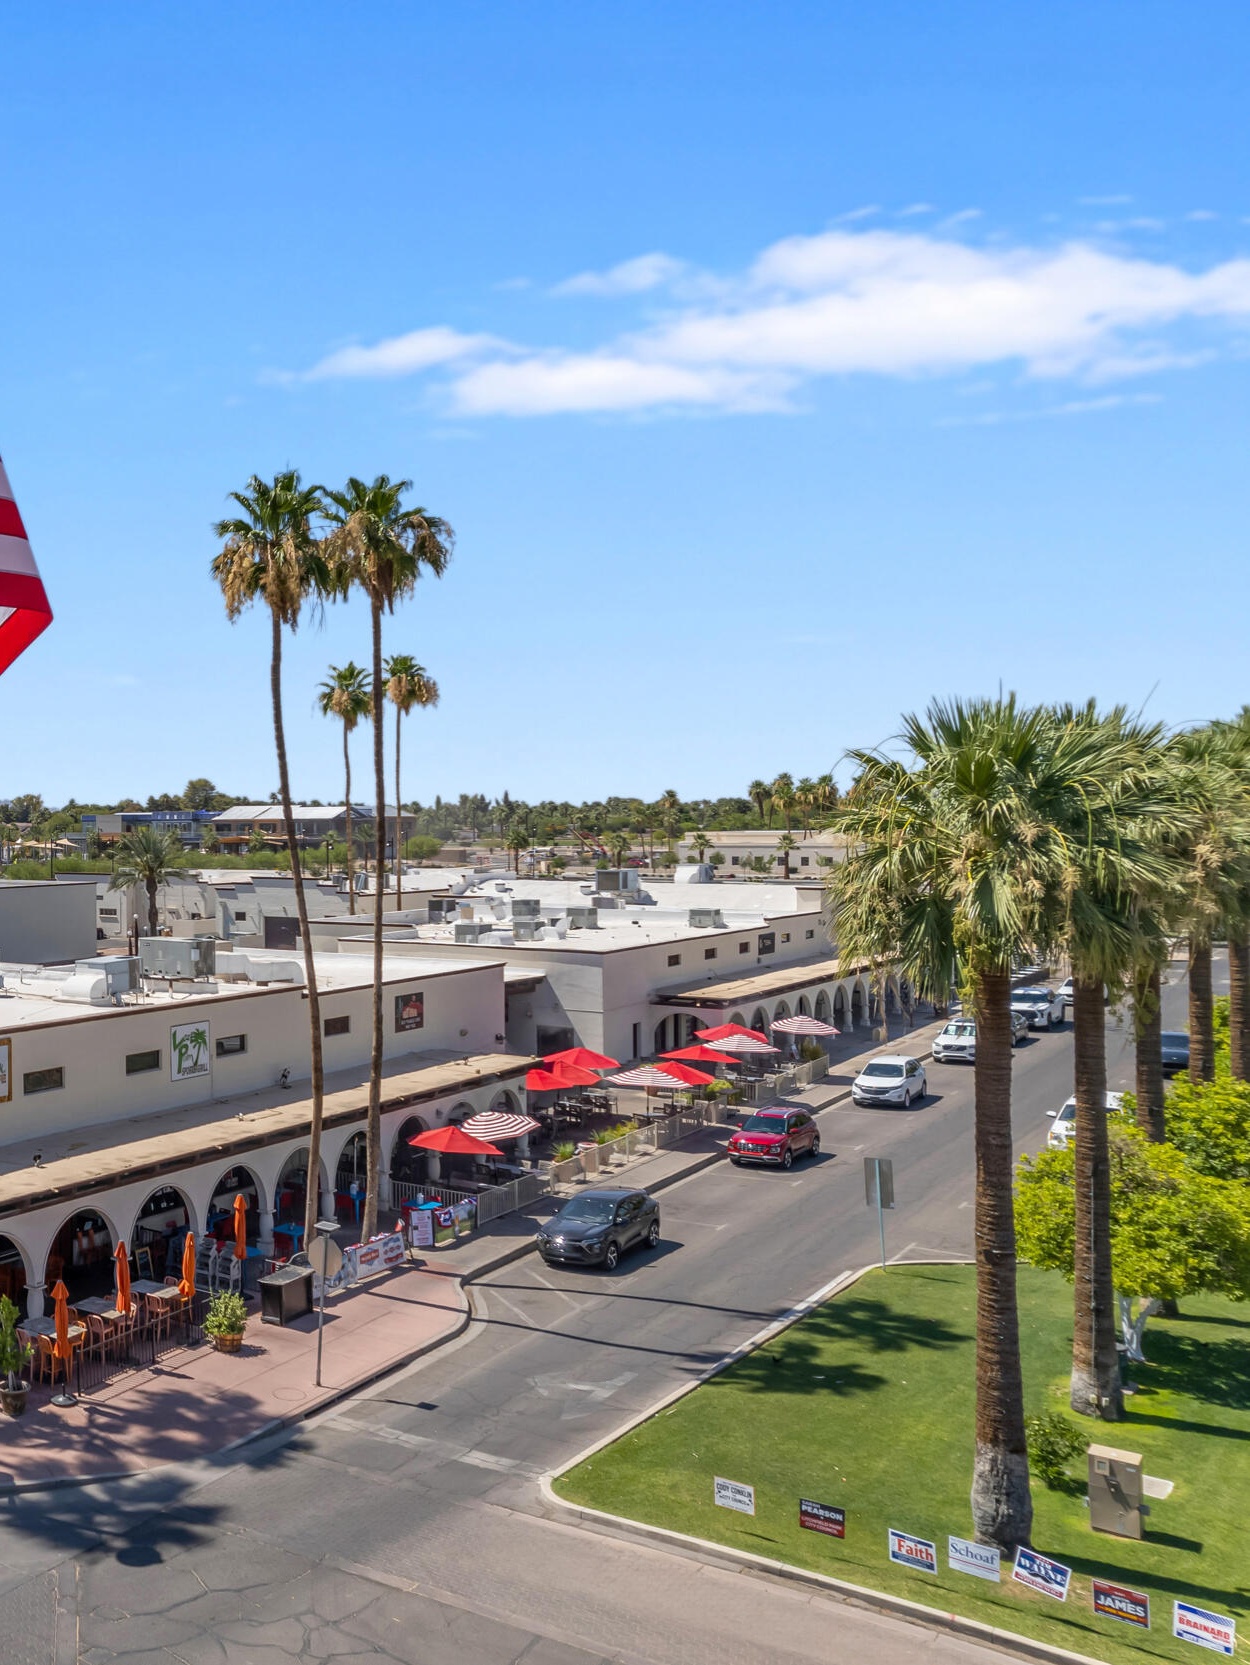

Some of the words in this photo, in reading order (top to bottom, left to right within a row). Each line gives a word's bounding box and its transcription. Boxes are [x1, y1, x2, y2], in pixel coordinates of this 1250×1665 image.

[801, 1504, 844, 1521] PEARSON
[896, 1538, 935, 1563] Faith
[950, 1542, 999, 1565] Schoaf
[1019, 1556, 1066, 1585] WAYNE
[1096, 1594, 1146, 1617] JAMES
[1178, 1616, 1231, 1640] BRAINARD
